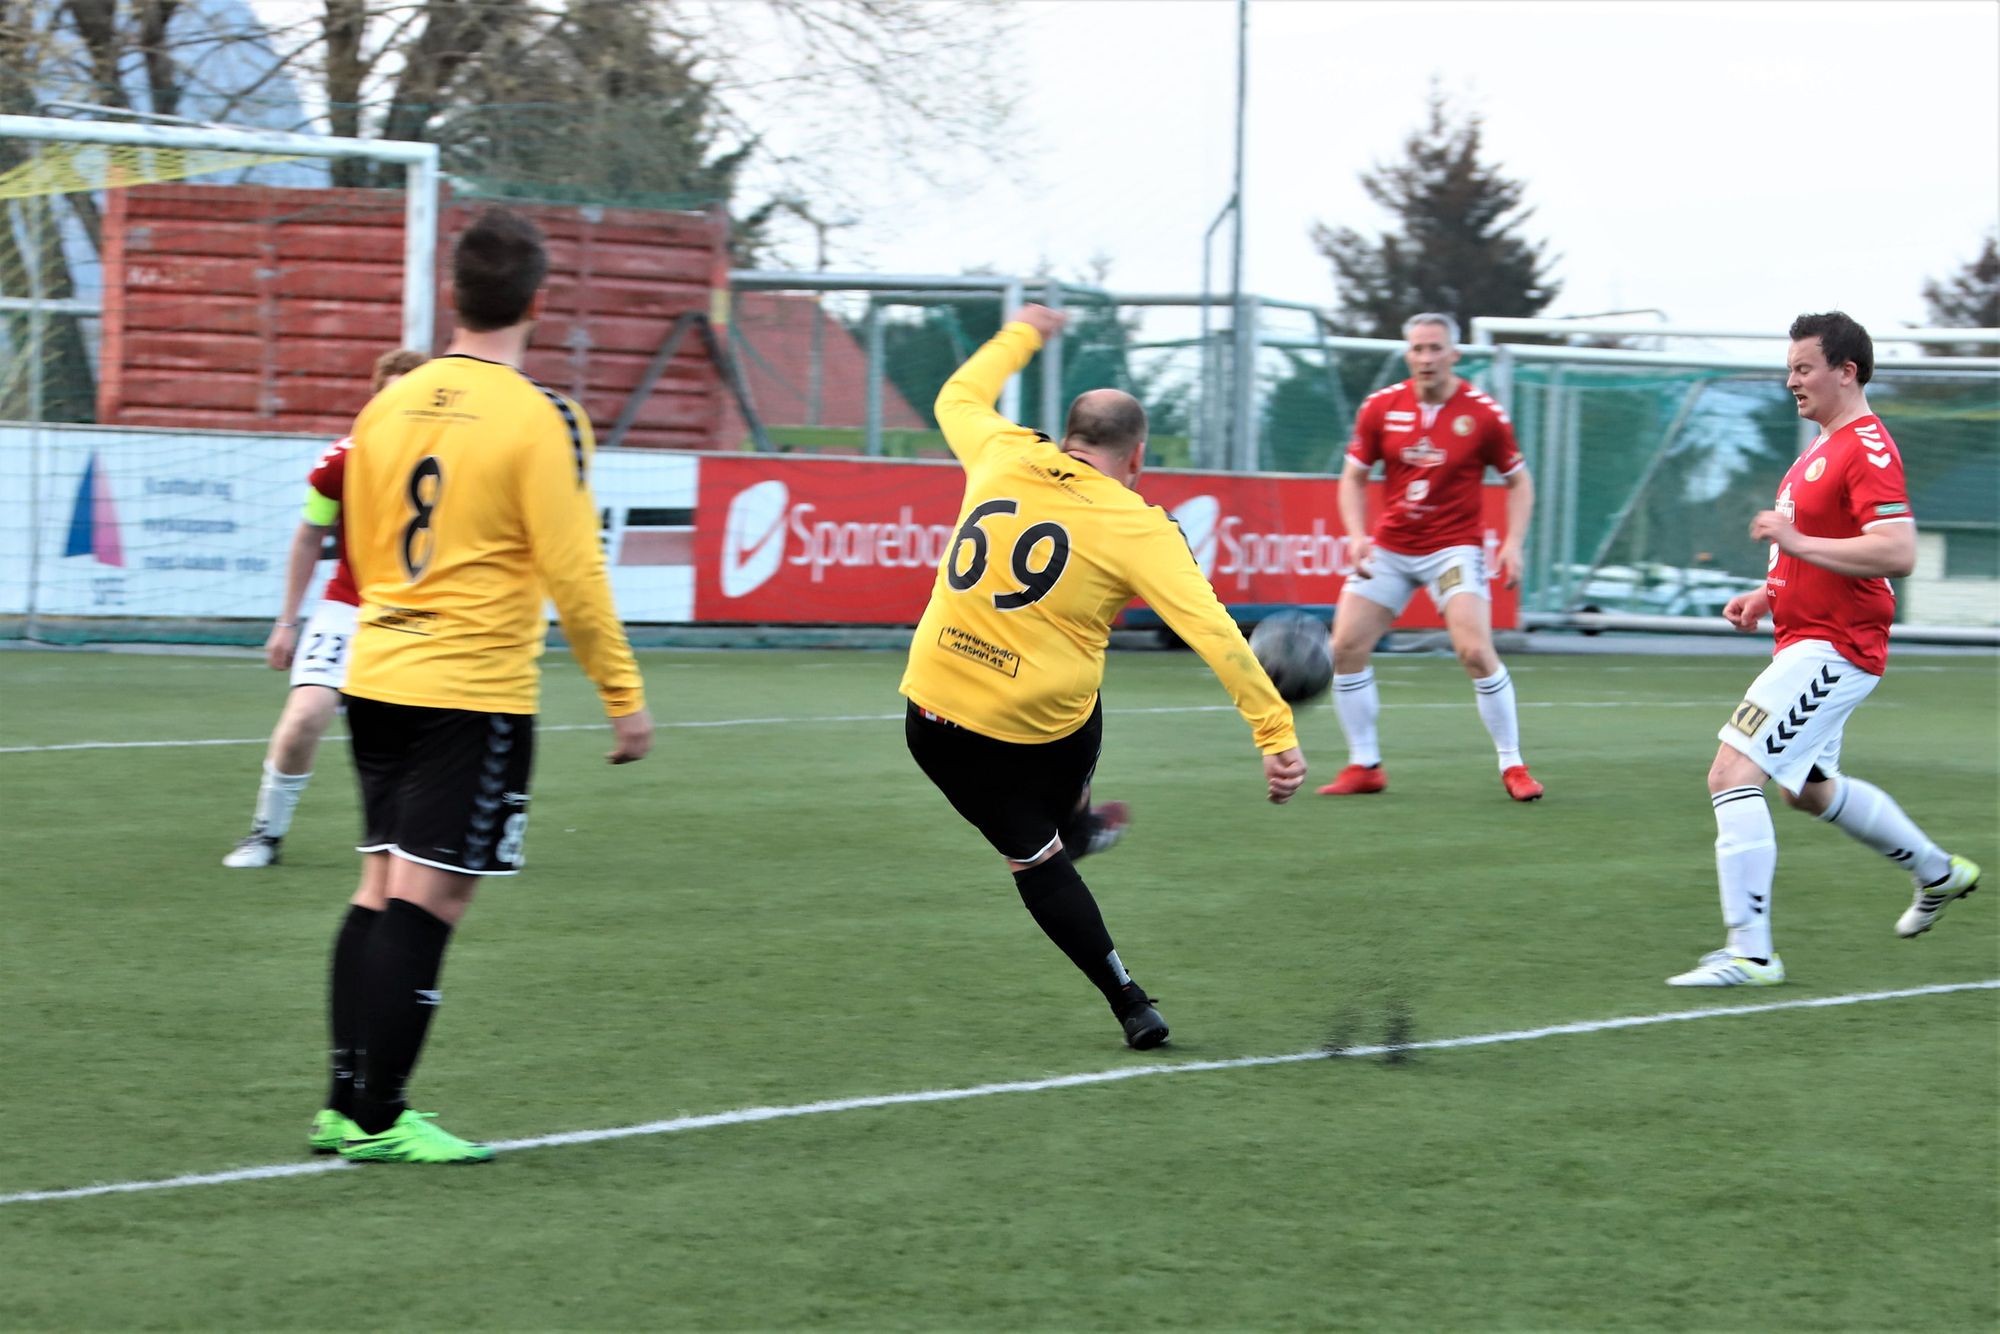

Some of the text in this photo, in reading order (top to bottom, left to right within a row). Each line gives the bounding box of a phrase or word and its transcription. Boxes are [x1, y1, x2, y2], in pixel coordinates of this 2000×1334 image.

[401, 455, 444, 584] 8
[788, 503, 957, 583] Spareba
[946, 497, 1072, 613] 69
[304, 633, 348, 665] 23
